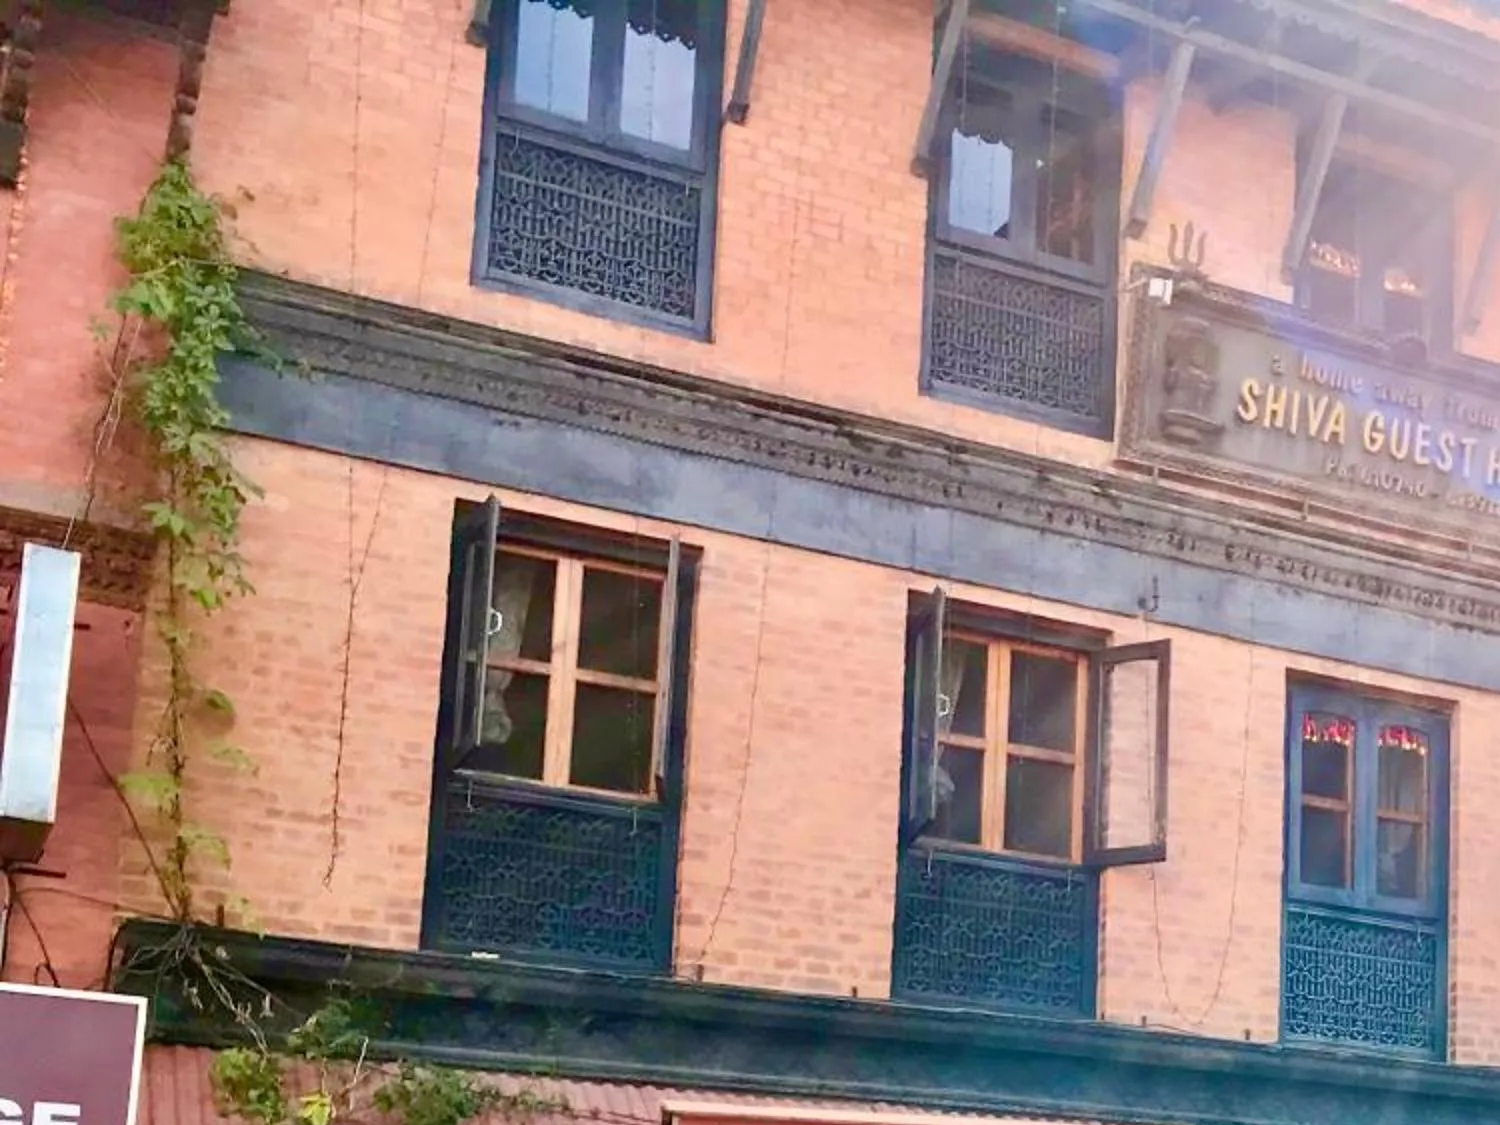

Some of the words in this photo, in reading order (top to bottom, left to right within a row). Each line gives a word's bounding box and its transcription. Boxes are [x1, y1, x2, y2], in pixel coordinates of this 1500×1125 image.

[1301, 352, 1364, 394] home
[1237, 378, 1346, 445] SHIVA
[1363, 408, 1478, 479] GUEST
